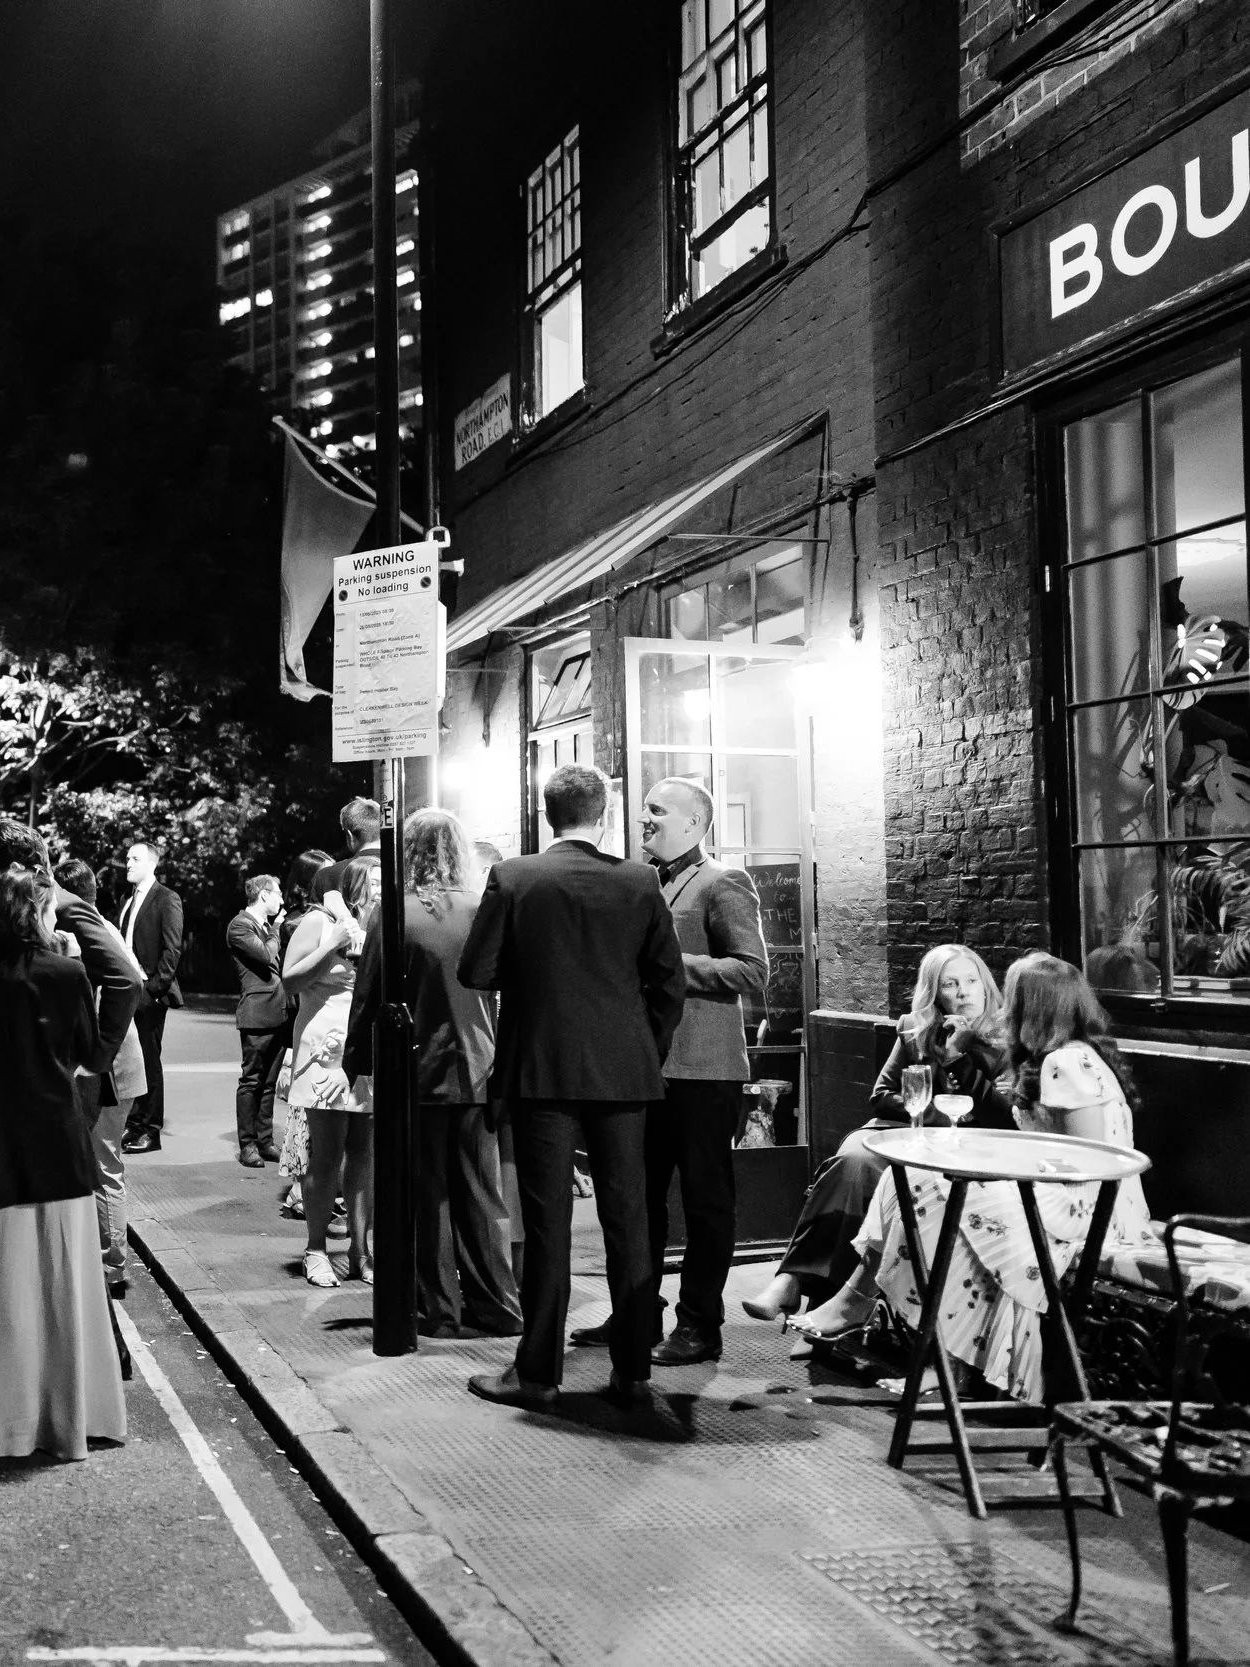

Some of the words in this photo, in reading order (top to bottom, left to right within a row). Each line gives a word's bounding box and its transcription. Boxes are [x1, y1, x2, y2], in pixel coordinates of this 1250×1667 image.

[457, 391, 508, 444] NORTHAMPTON
[353, 550, 415, 571] WARNING
[338, 574, 372, 587] Parking
[375, 565, 432, 580] suspension
[358, 588, 371, 597] No
[373, 582, 409, 594] loading
[342, 732, 427, 745] www.islington.gov.uk/parking
